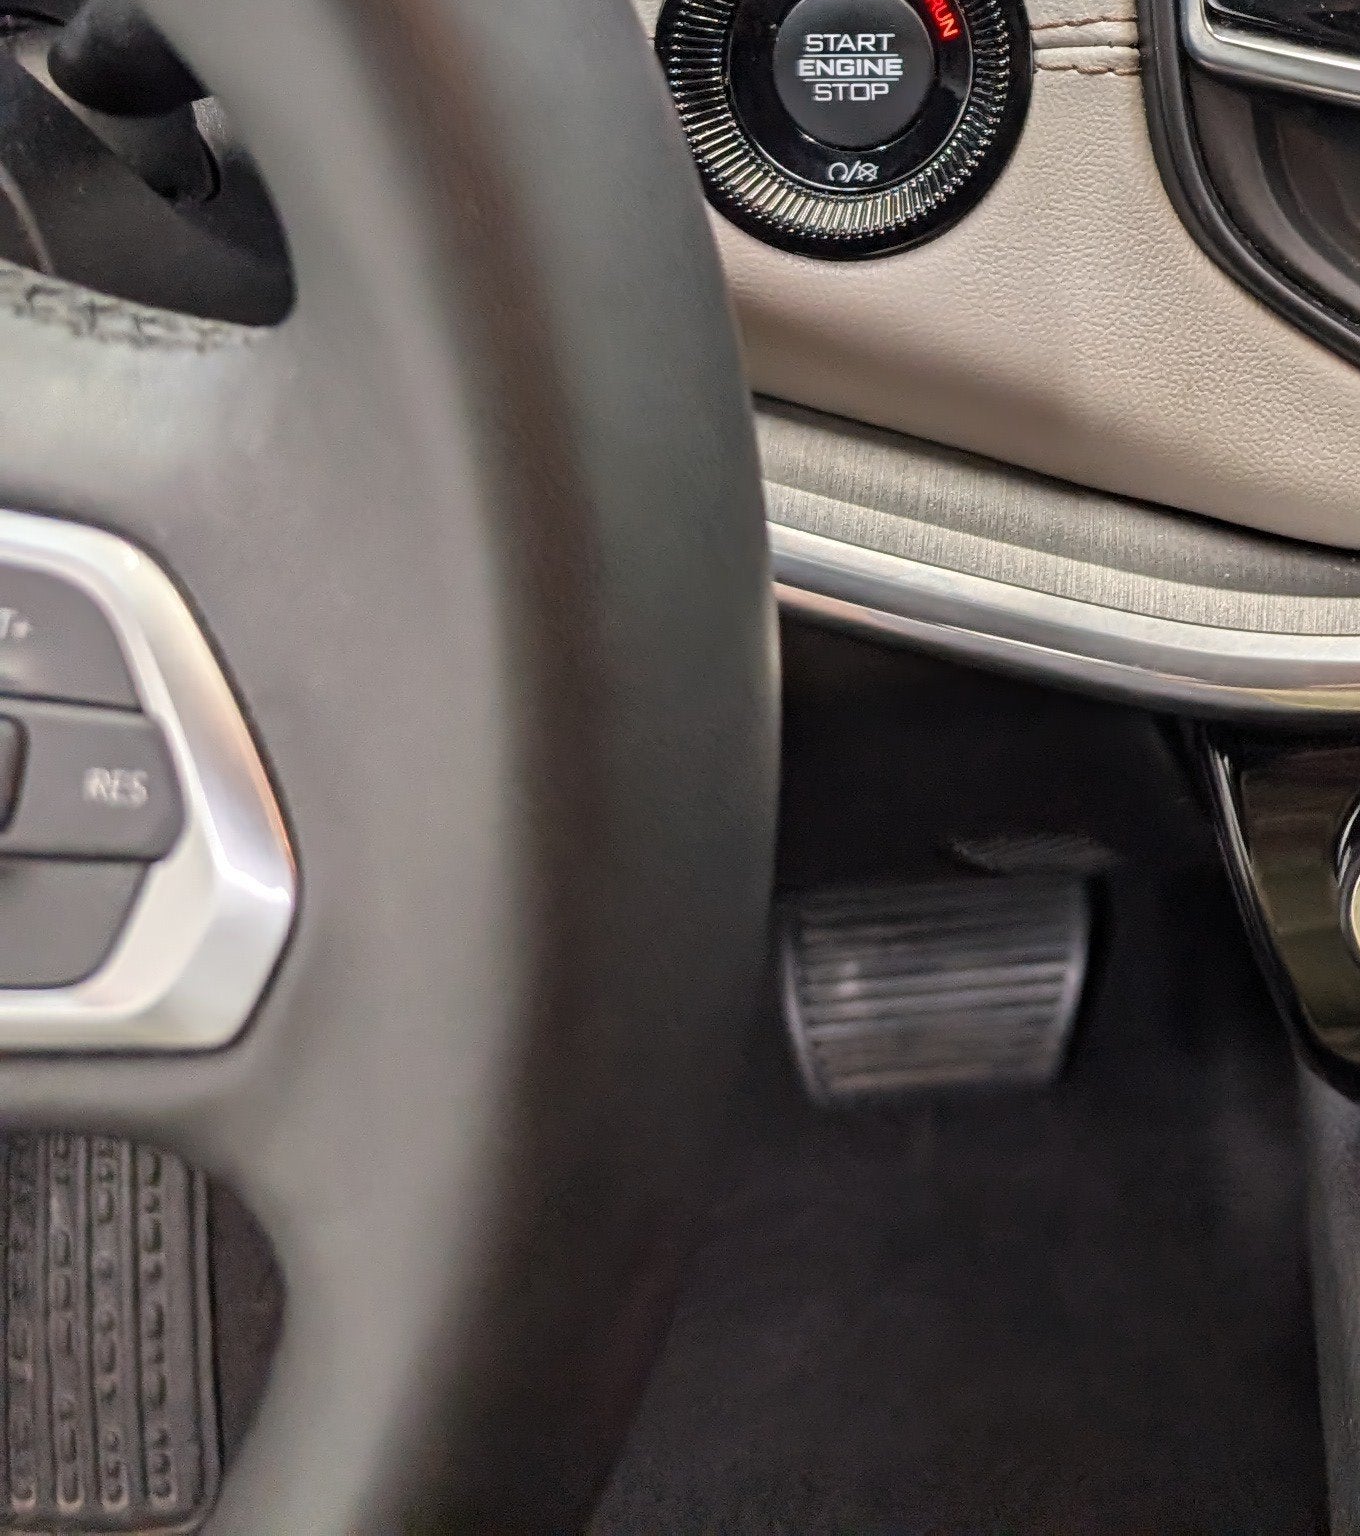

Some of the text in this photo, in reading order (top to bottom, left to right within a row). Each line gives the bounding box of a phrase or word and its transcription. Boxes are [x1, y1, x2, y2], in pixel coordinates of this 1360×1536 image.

[806, 34, 895, 51] START
[798, 59, 903, 77] ENGINE
[814, 83, 890, 102] STOP
[84, 766, 148, 805] RES
